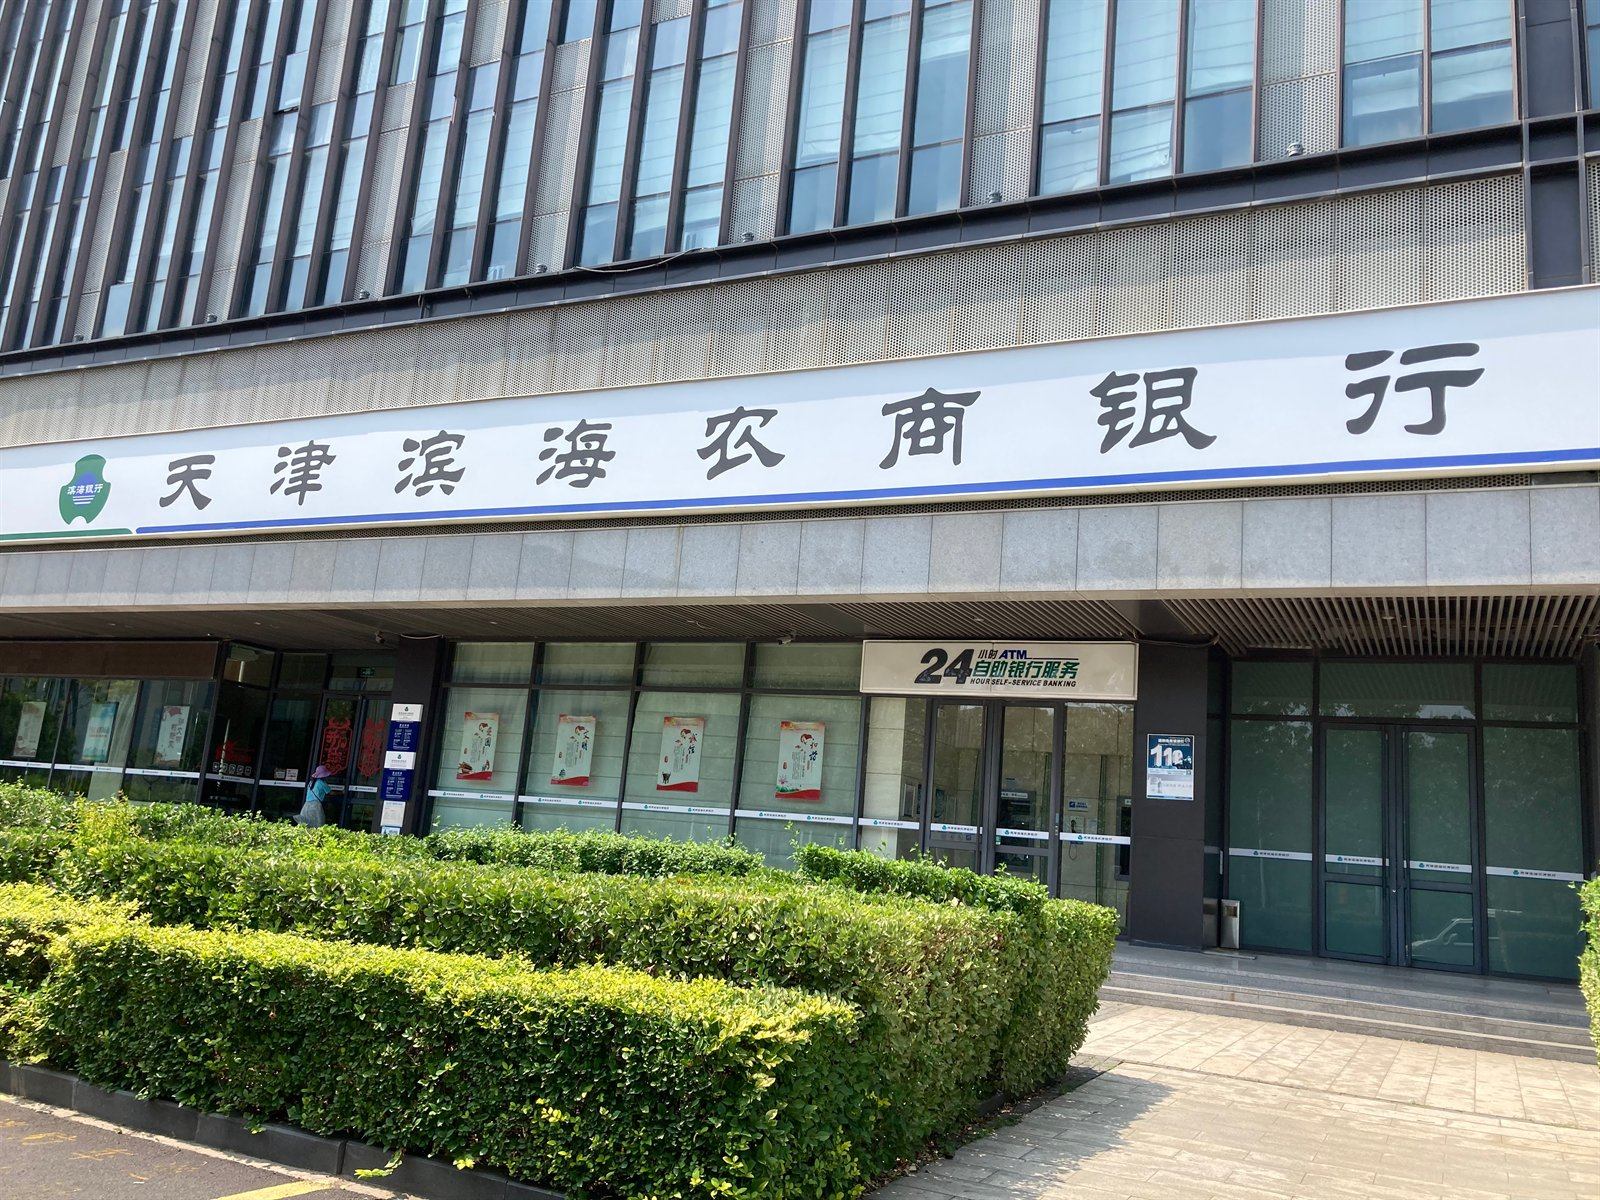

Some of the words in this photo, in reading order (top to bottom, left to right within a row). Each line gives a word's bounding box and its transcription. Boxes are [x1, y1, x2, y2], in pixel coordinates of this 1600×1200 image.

[158, 342, 1481, 511] 天津滨海农商银行
[67, 483, 103, 495] 滨海银行
[978, 649, 998, 660] 小时
[999, 649, 1028, 660] ATM
[914, 648, 974, 685] 24
[972, 660, 1080, 680] 自助银行服务
[1042, 680, 1077, 688] BANKING
